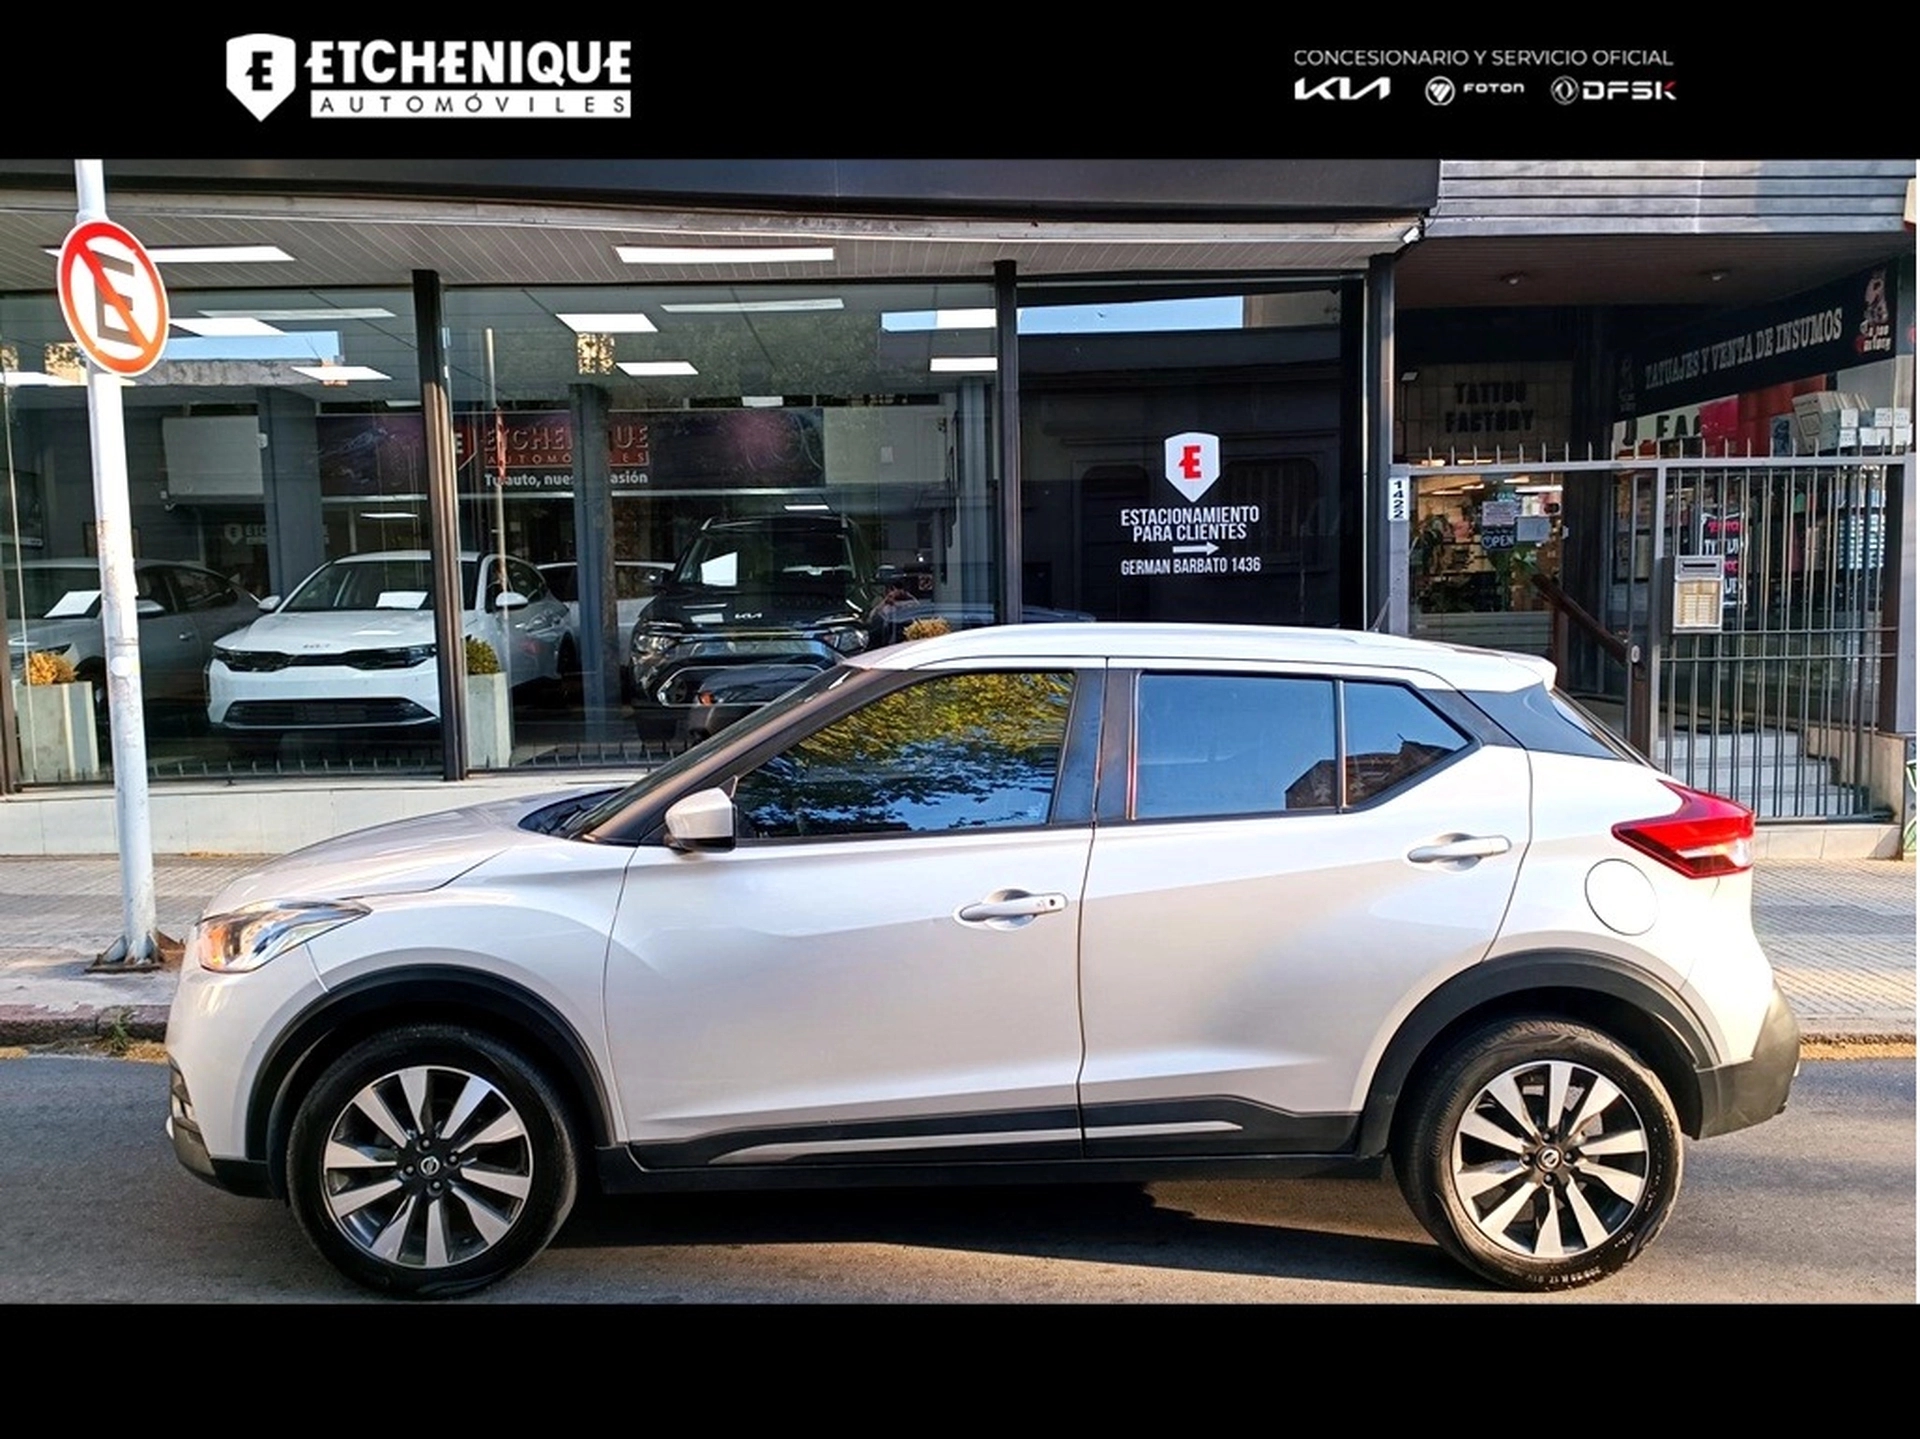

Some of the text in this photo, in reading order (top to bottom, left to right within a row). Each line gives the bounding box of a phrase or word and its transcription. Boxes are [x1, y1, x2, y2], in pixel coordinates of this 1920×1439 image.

[94, 250, 143, 347] E
[1711, 332, 1753, 372] VENTA
[1755, 325, 1774, 360] DE
[1776, 307, 1843, 354] INSUMOS
[1445, 409, 1534, 434] FACTORY
[1393, 480, 1404, 519] 1422
[1121, 505, 1260, 527] ESTACIONAMIENTO
[1133, 522, 1247, 542] PARA CLIENTES
[1121, 556, 1261, 576] GERMAN BARBATO 1436
